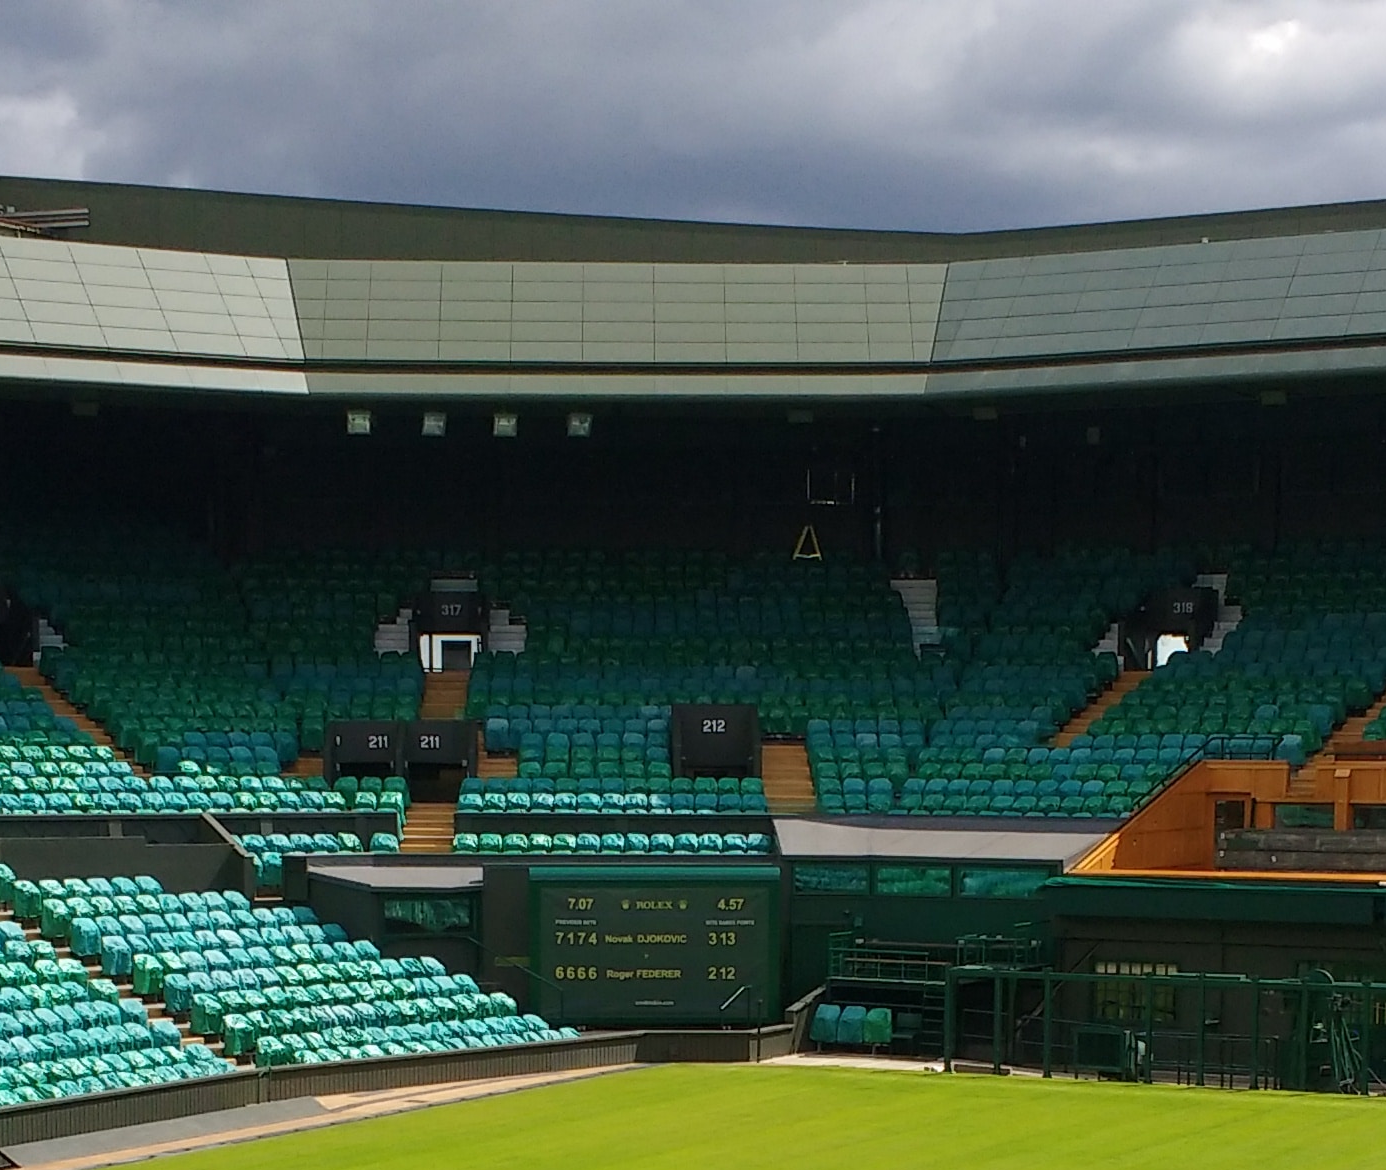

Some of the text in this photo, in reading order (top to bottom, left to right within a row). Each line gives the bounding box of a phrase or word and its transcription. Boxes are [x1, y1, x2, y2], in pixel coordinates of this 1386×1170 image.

[441, 604, 462, 616] 317
[1173, 602, 1193, 614] 318
[703, 719, 726, 733] 212
[368, 735, 389, 749] 211
[420, 735, 440, 749] 211
[568, 898, 594, 910] 7.07
[636, 900, 673, 910] ROLEX
[717, 898, 744, 910] 4.57
[605, 934, 687, 944] Novak DJOKOVIC
[606, 969, 682, 980] Roger FEDERER
